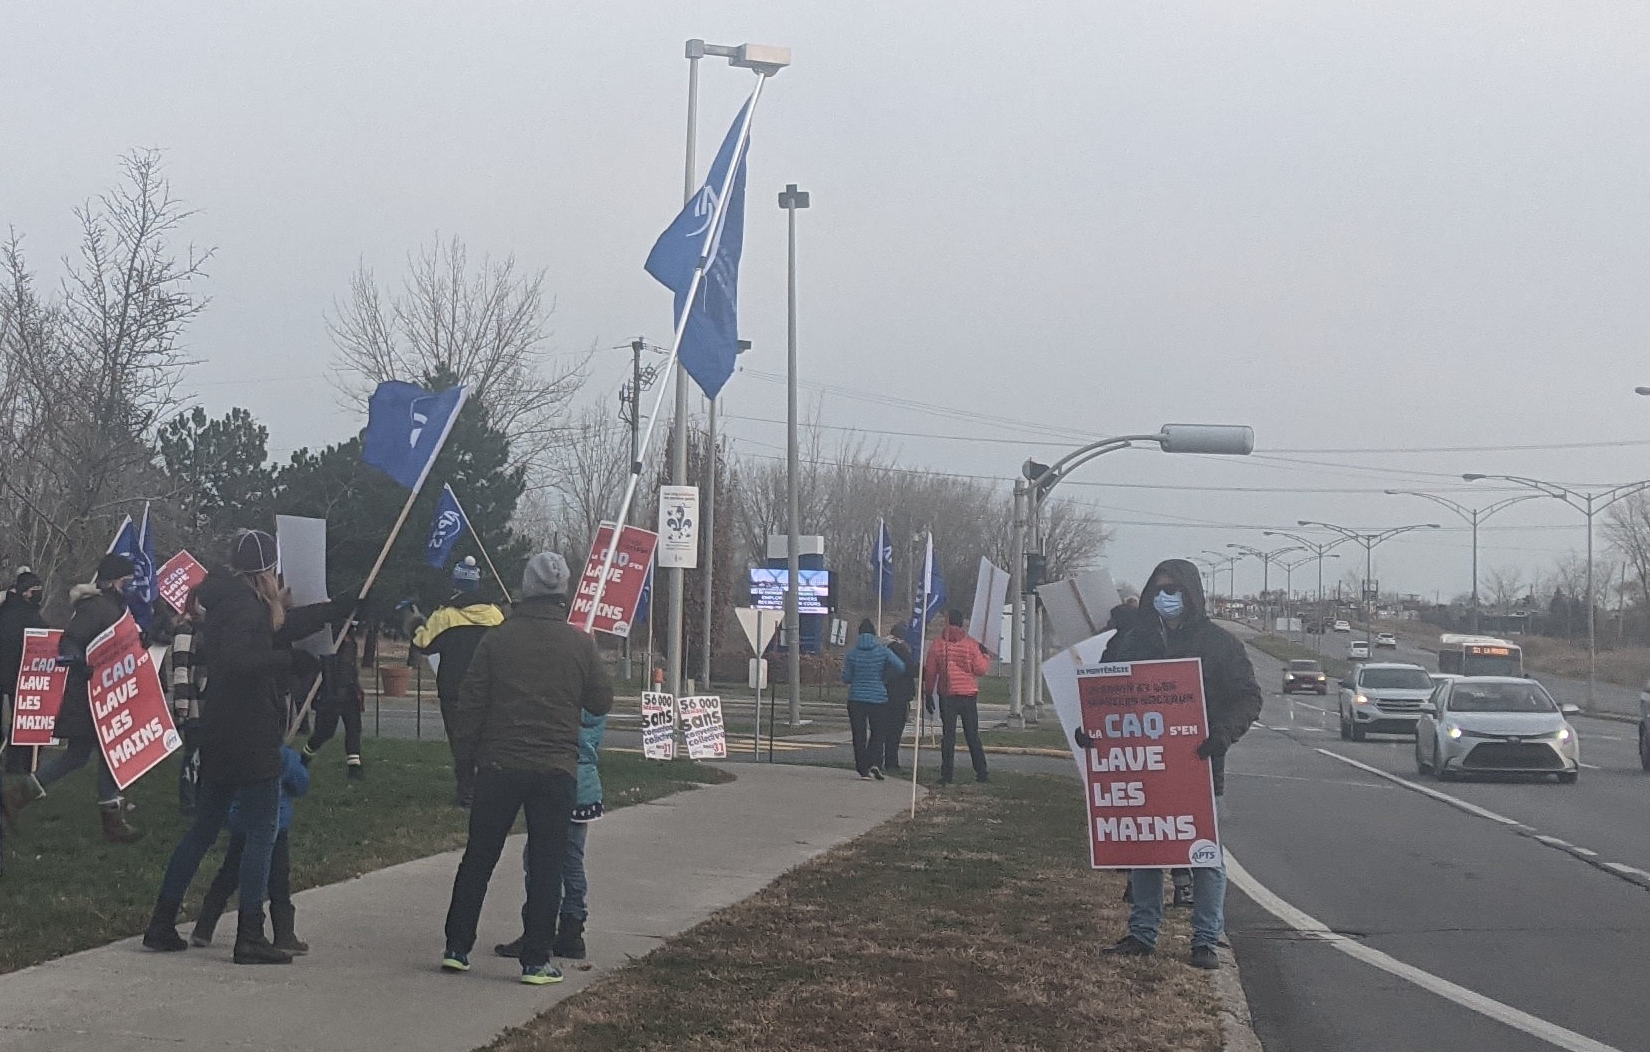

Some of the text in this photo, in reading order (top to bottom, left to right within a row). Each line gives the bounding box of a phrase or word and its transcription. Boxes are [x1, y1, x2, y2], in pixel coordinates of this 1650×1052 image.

[31, 657, 55, 673] CAQ
[102, 653, 136, 689] CAQ
[20, 675, 50, 691] LAVE
[18, 694, 41, 710] LES
[95, 676, 139, 720] LAVE
[644, 694, 657, 705] 56
[658, 695, 672, 708] 000
[680, 698, 719, 710] 56 000
[16, 714, 56, 730] MAINS
[101, 708, 133, 745] LES
[642, 710, 673, 729] sans
[679, 711, 722, 732] sans
[1088, 711, 1198, 740] LA CAQ S'EN
[108, 716, 164, 769] MAINS
[713, 742, 724, 752] 31
[1090, 745, 1166, 772] LAVE
[1093, 782, 1146, 807] LES
[1096, 815, 1197, 842] MAINS
[1192, 851, 1216, 862] APTS
